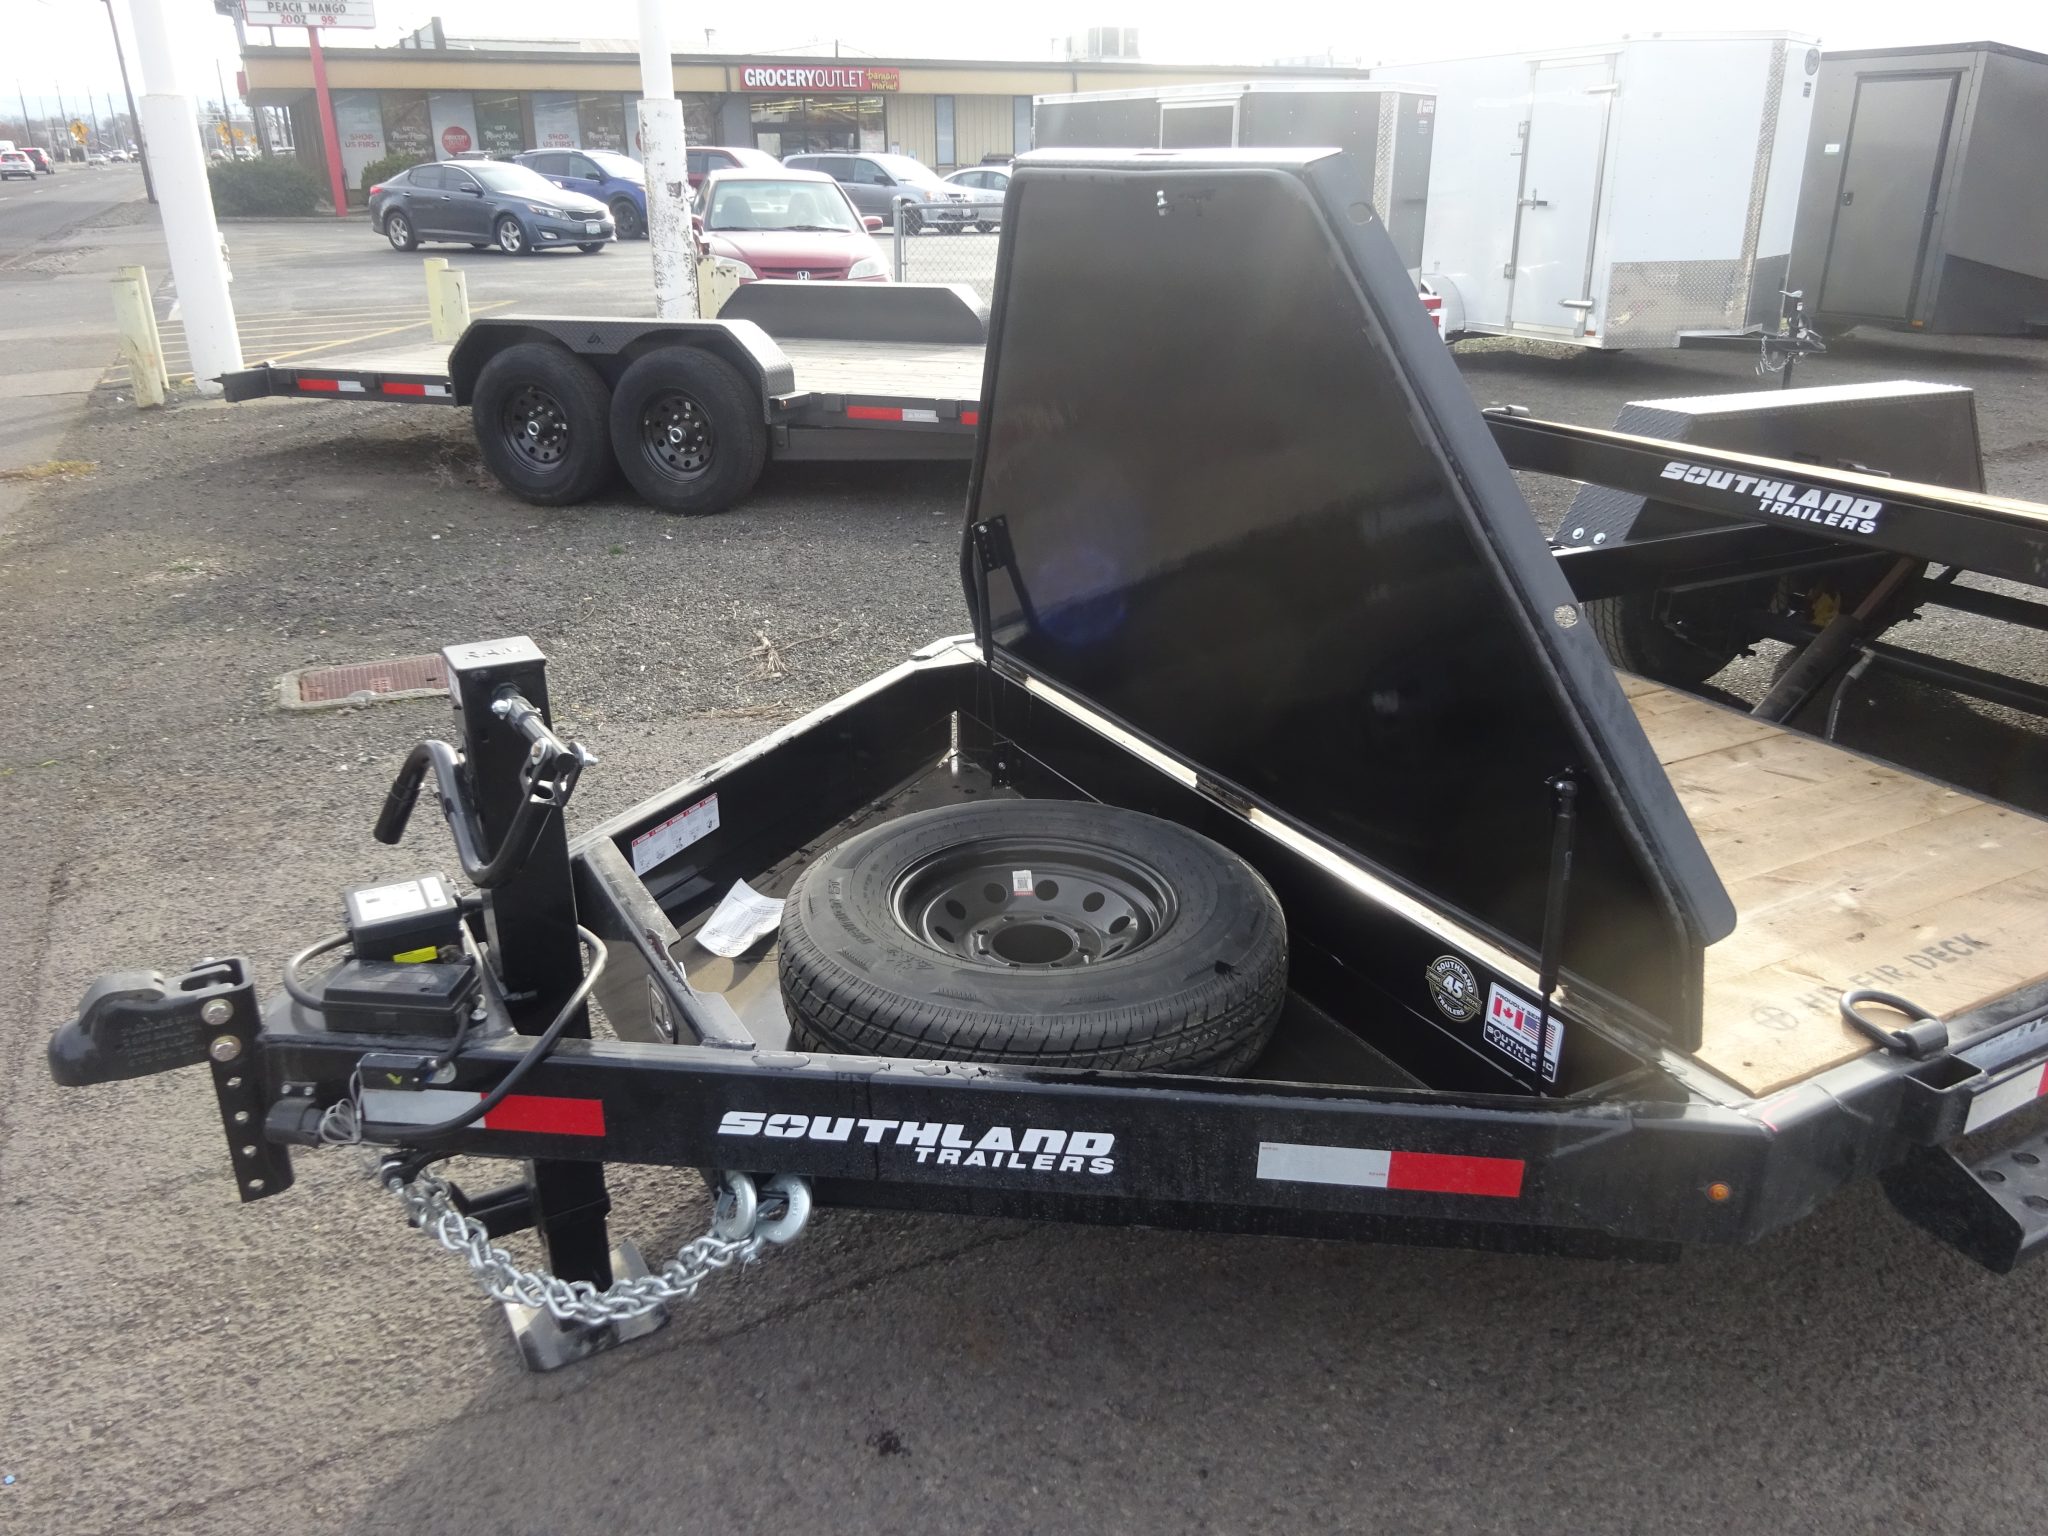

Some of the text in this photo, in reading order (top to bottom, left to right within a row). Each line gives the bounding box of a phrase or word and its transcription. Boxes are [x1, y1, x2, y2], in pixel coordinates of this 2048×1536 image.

[267, 2, 346, 14] PEACH MANGO
[1659, 461, 1883, 520] SOUTHLAND
[1758, 498, 1877, 534] TRAILERS
[1904, 933, 1991, 970] DECK
[1436, 961, 1474, 993] SOUTHLAND
[1442, 975, 1464, 999] 45
[1438, 994, 1465, 1016] TRAILERS
[1495, 991, 1525, 1012] PROUDLY
[717, 1110, 1115, 1156] SOUTHLAND
[914, 1146, 1114, 1175] TRAILERS
